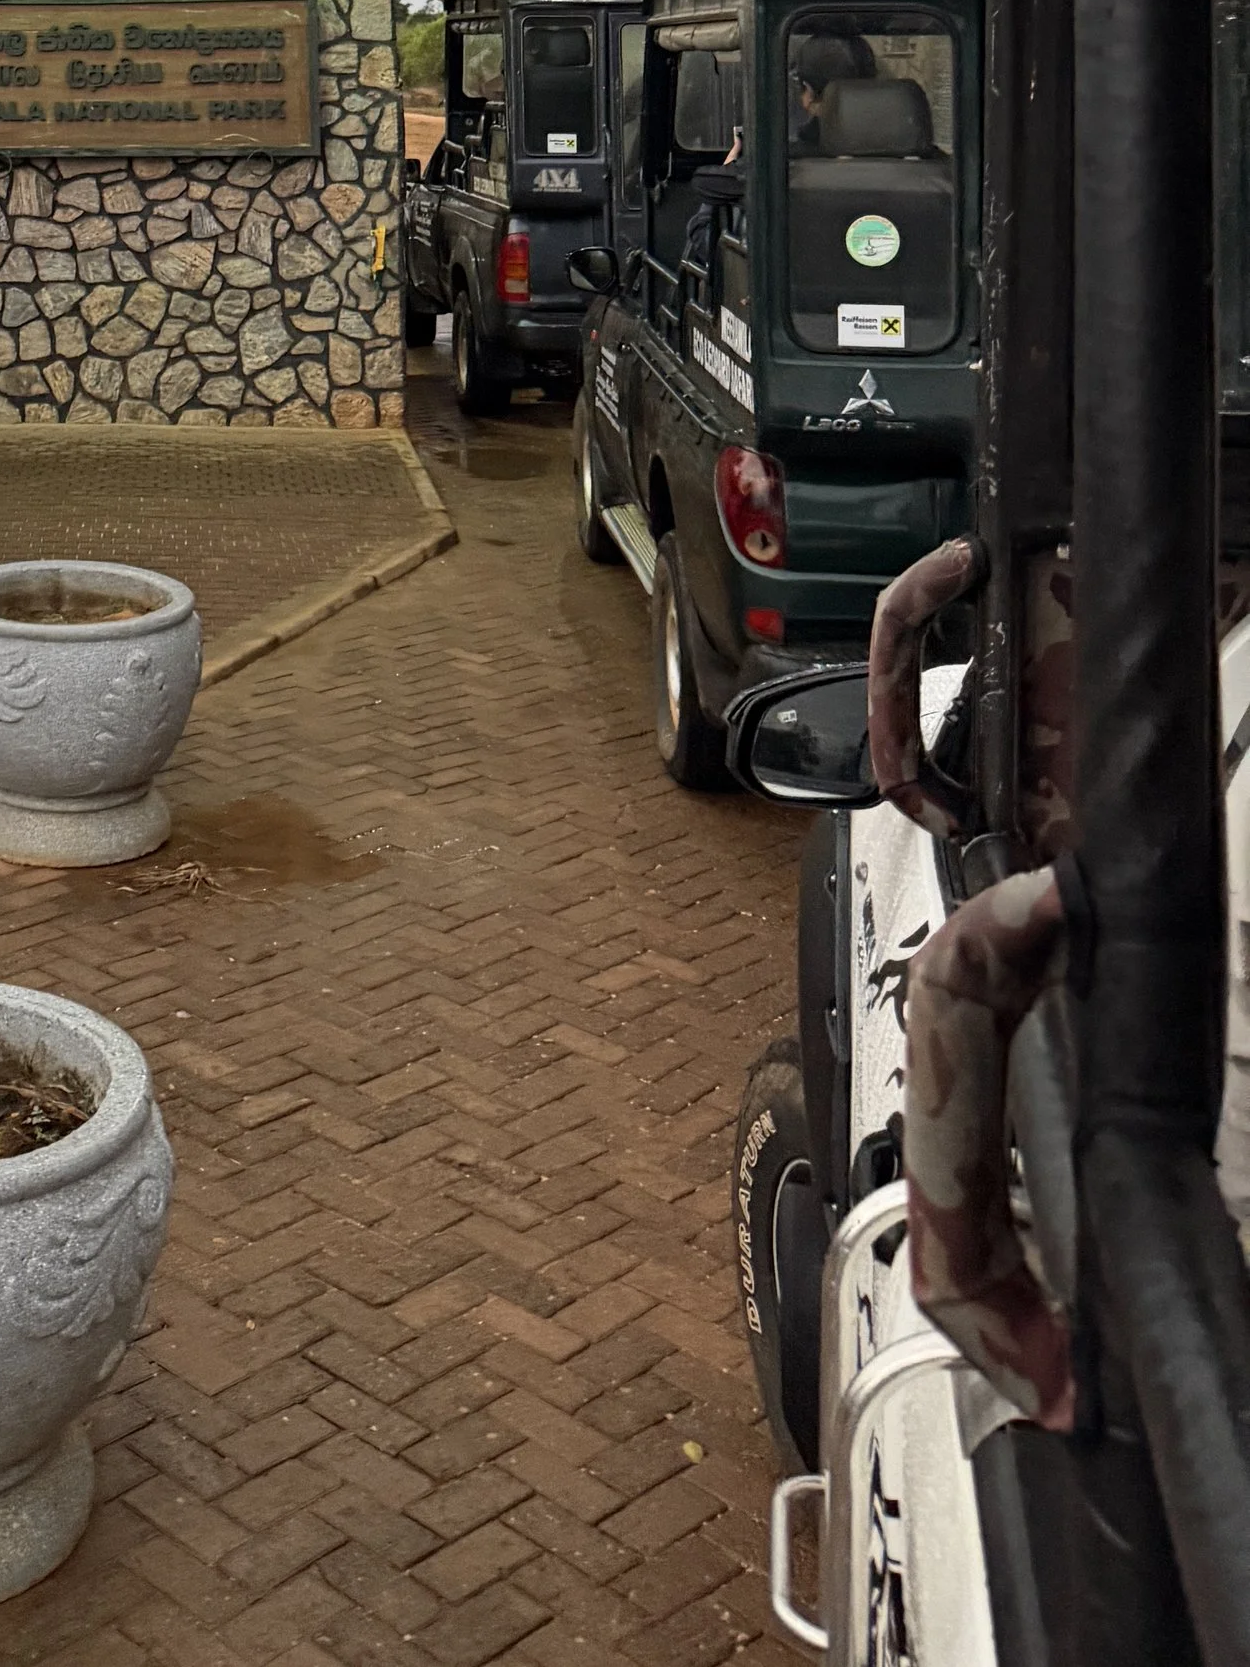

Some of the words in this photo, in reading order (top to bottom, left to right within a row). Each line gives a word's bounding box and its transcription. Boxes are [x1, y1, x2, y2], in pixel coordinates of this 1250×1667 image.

[54, 99, 200, 122] NATIONAL
[209, 100, 286, 121] PARK
[738, 1110, 778, 1335] DURATURN
